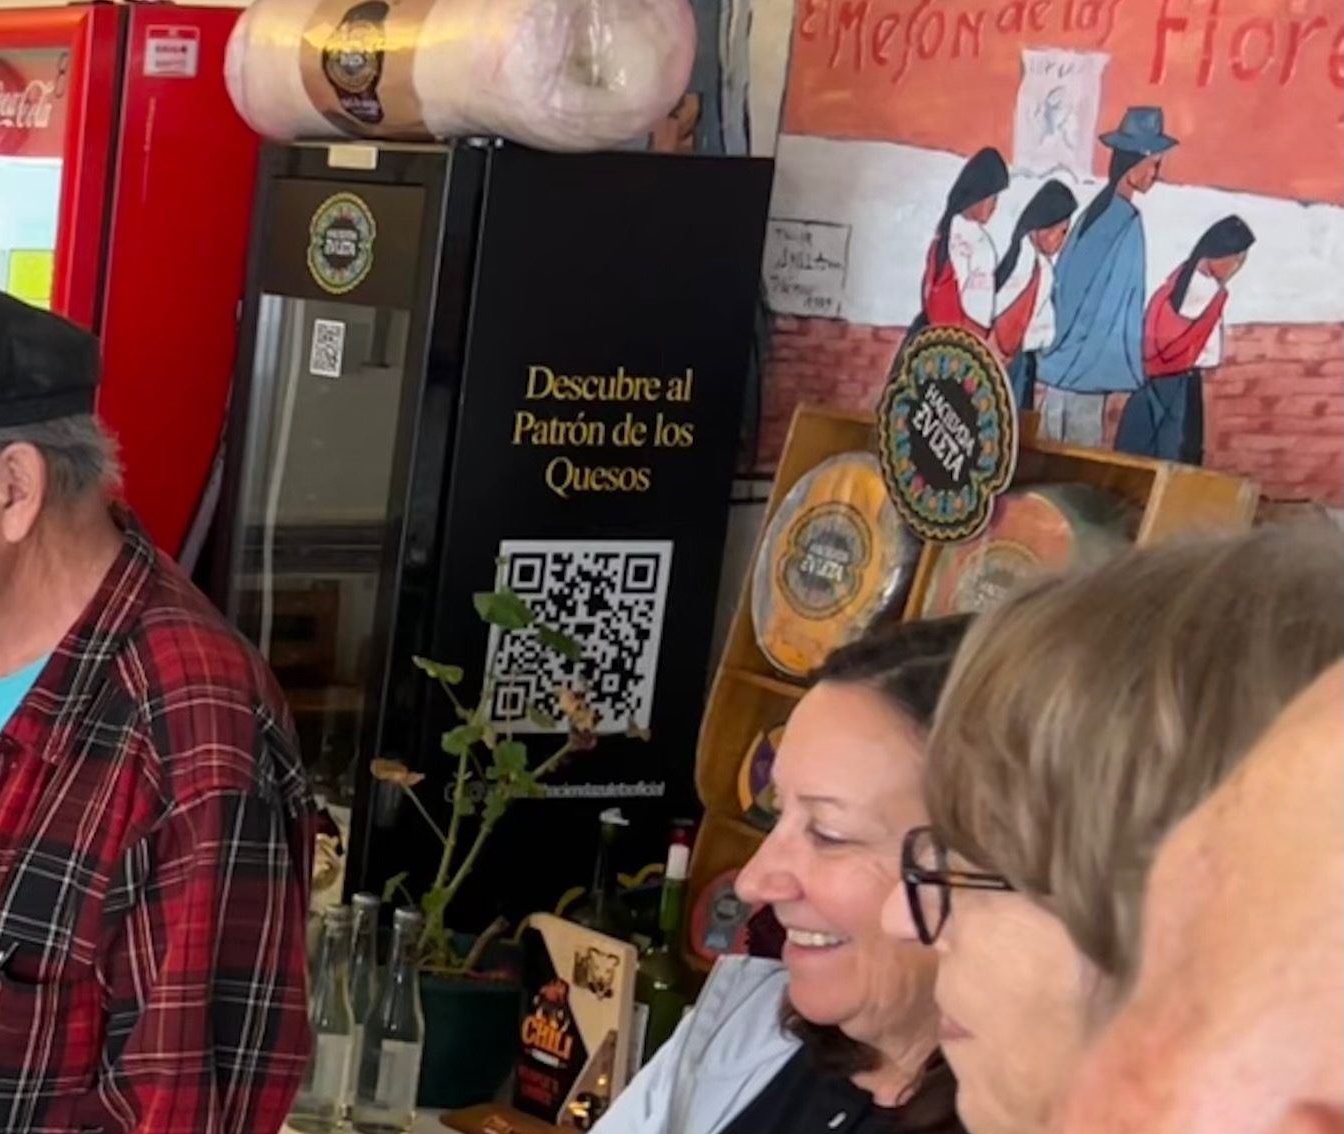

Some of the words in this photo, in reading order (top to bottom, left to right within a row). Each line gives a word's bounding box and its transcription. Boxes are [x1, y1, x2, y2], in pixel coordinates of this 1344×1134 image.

[525, 365, 662, 401] Descubre
[665, 367, 694, 402] al
[512, 410, 606, 446] Patrón
[613, 412, 648, 447] de
[653, 412, 695, 447] los
[544, 456, 652, 499] Quesos
